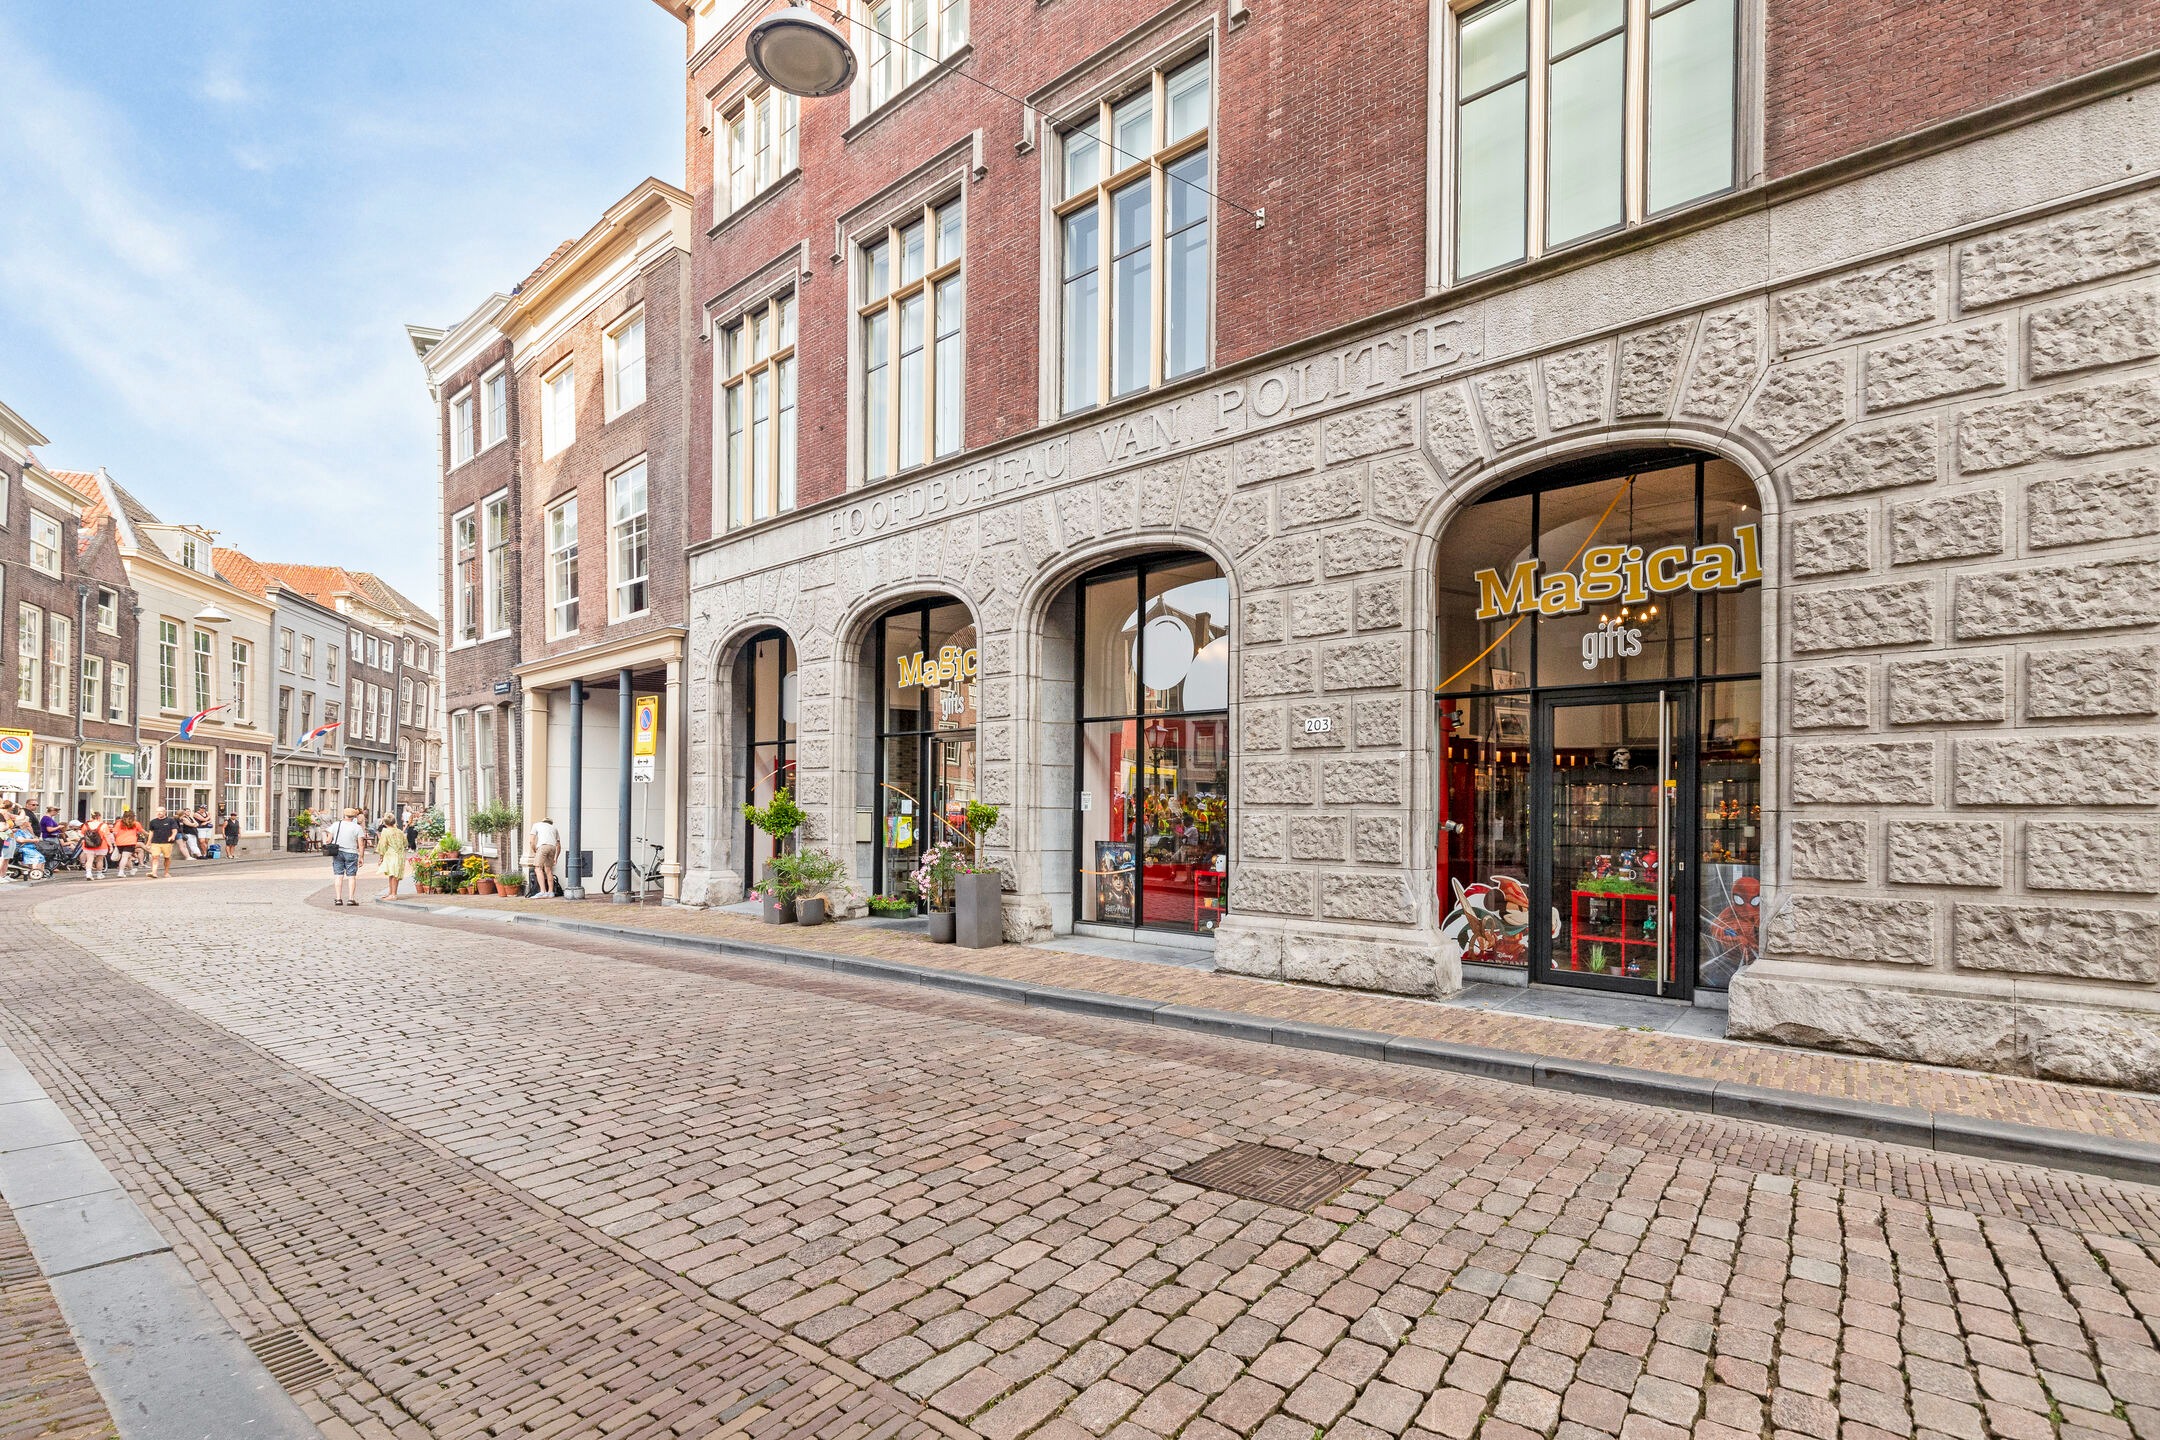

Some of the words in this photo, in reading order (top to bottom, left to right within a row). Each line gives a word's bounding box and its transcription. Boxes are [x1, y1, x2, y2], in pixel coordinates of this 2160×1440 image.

[828, 440, 1069, 544] HOOFDBUREAU
[1096, 405, 1182, 462] VAN
[1474, 523, 1762, 620] Magical
[897, 645, 977, 688] Magic
[1582, 619, 1642, 670] gifts
[941, 692, 965, 721] gifts
[1307, 719, 1329, 732] 203
